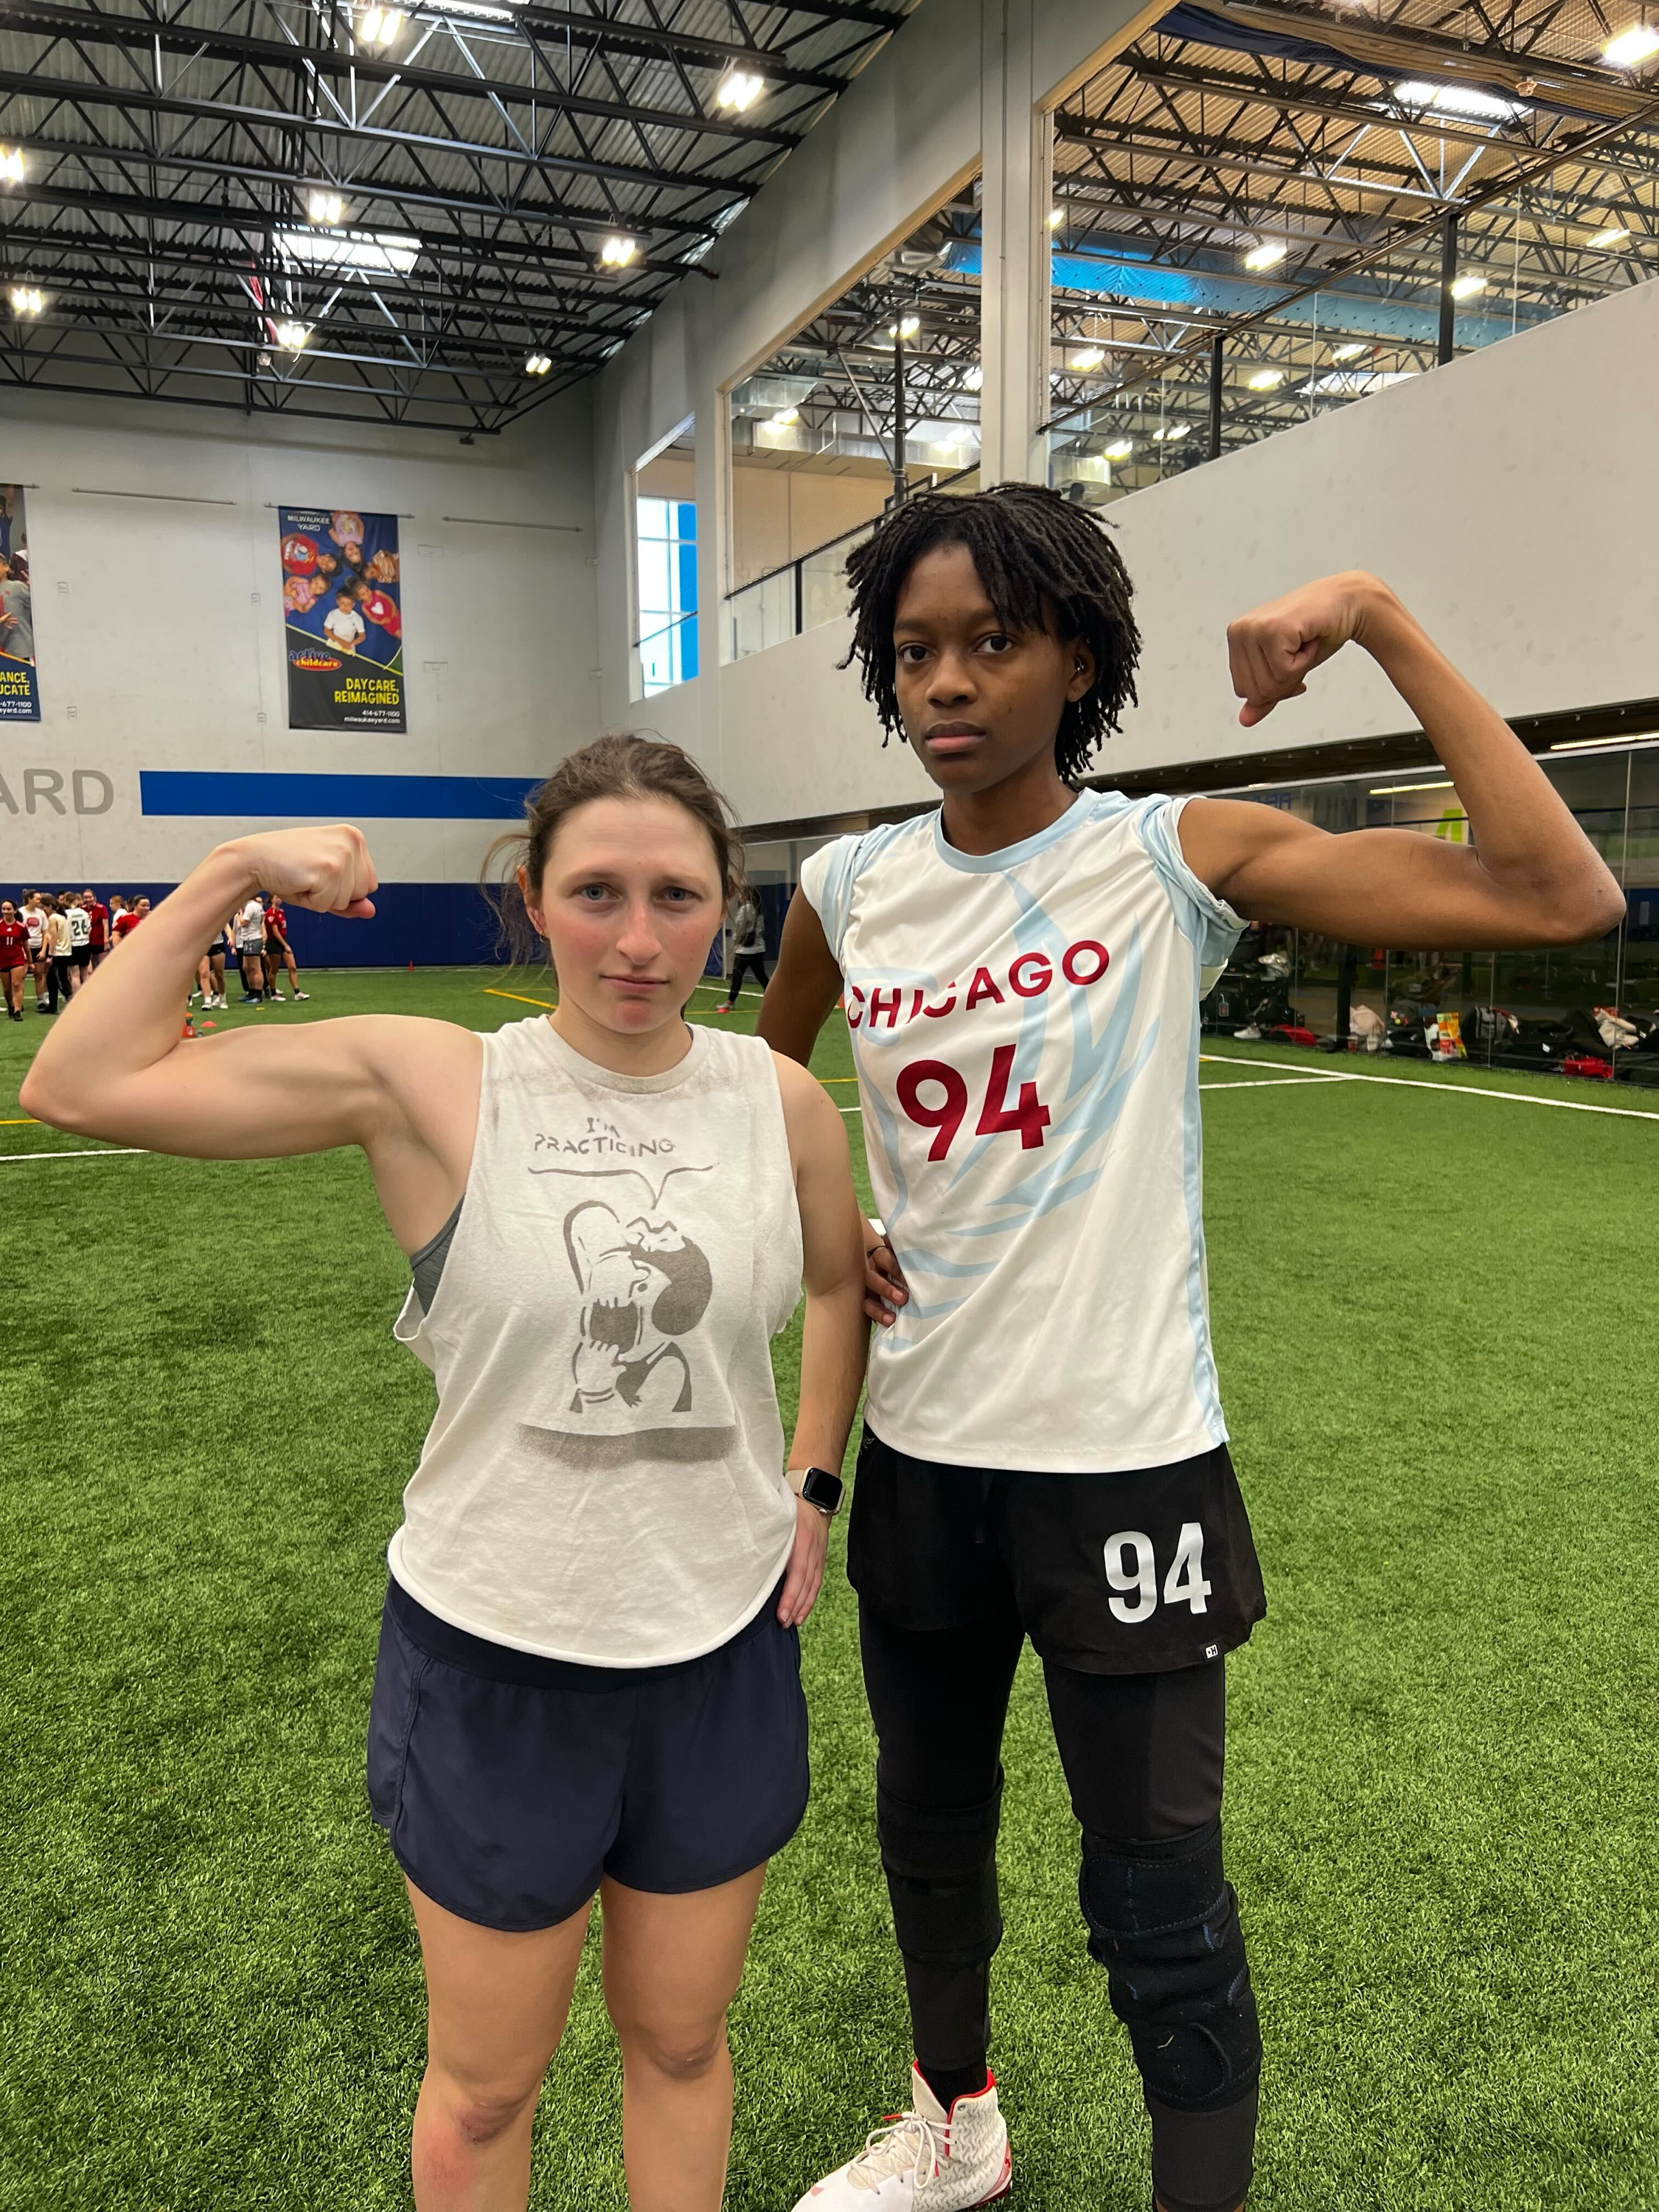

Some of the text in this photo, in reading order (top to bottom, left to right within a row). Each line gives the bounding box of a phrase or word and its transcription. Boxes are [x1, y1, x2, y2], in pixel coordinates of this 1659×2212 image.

[288, 515, 330, 524] MILWAUKEE
[297, 523, 321, 532] YARD
[289, 647, 331, 661] active
[296, 656, 338, 667] childcare
[346, 677, 400, 693] DAYCARE,
[334, 690, 400, 705] REIMAGINED
[72, 919, 88, 936] 26
[6, 936, 13, 945] 11
[847, 939, 1110, 1029] CHICAGO
[896, 1043, 1051, 1162] 94
[534, 1133, 677, 1157] PRACTICING
[1104, 1522, 1212, 1624] 94
